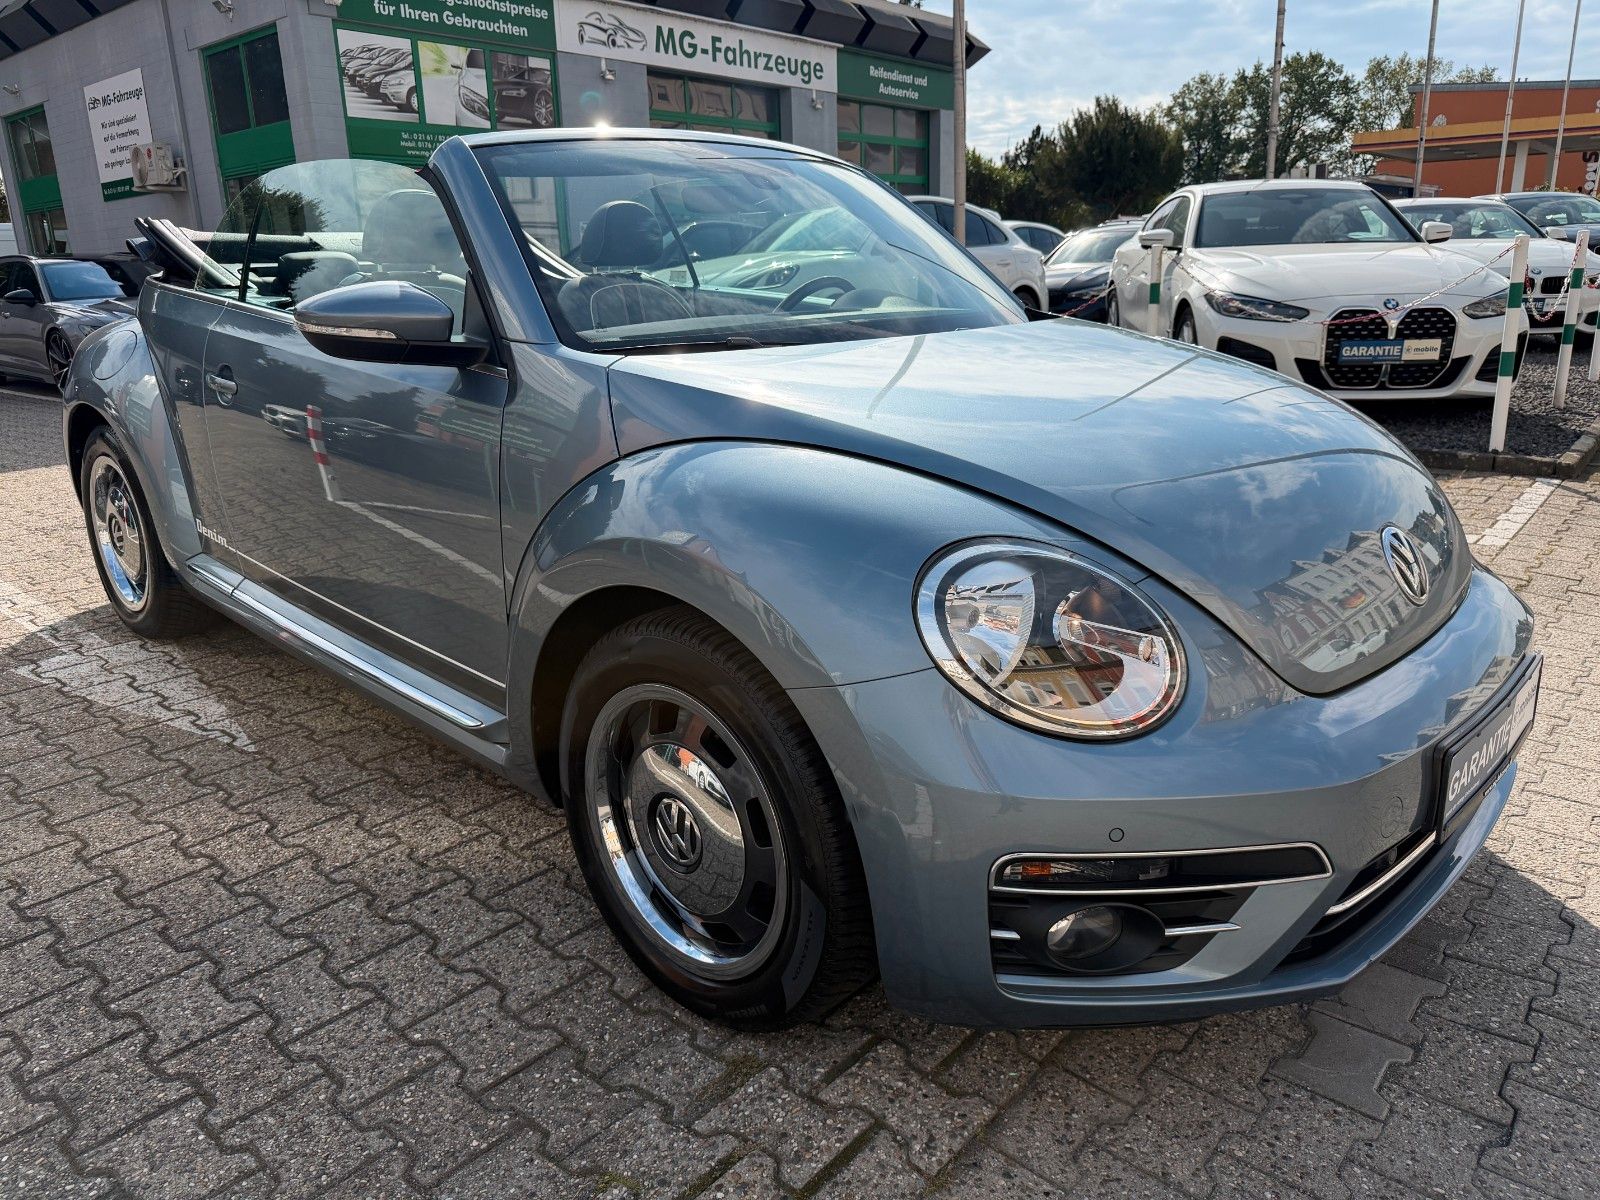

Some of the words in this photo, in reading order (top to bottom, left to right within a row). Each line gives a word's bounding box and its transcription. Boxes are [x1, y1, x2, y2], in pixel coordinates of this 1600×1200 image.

[374, 0, 396, 16] für
[400, 3, 439, 23] Ihren
[442, 11, 529, 37] Gebrauchten
[655, 25, 824, 85] MG-Fahrzeuge
[869, 65, 914, 84] Reifendienst
[914, 75, 928, 87] und
[101, 87, 142, 107] MG-Fahrzeuge
[879, 82, 919, 100] Autoservice
[1342, 345, 1402, 357] GARANTIE
[1413, 345, 1439, 354] mobile
[1448, 714, 1514, 802] GARANTIE
